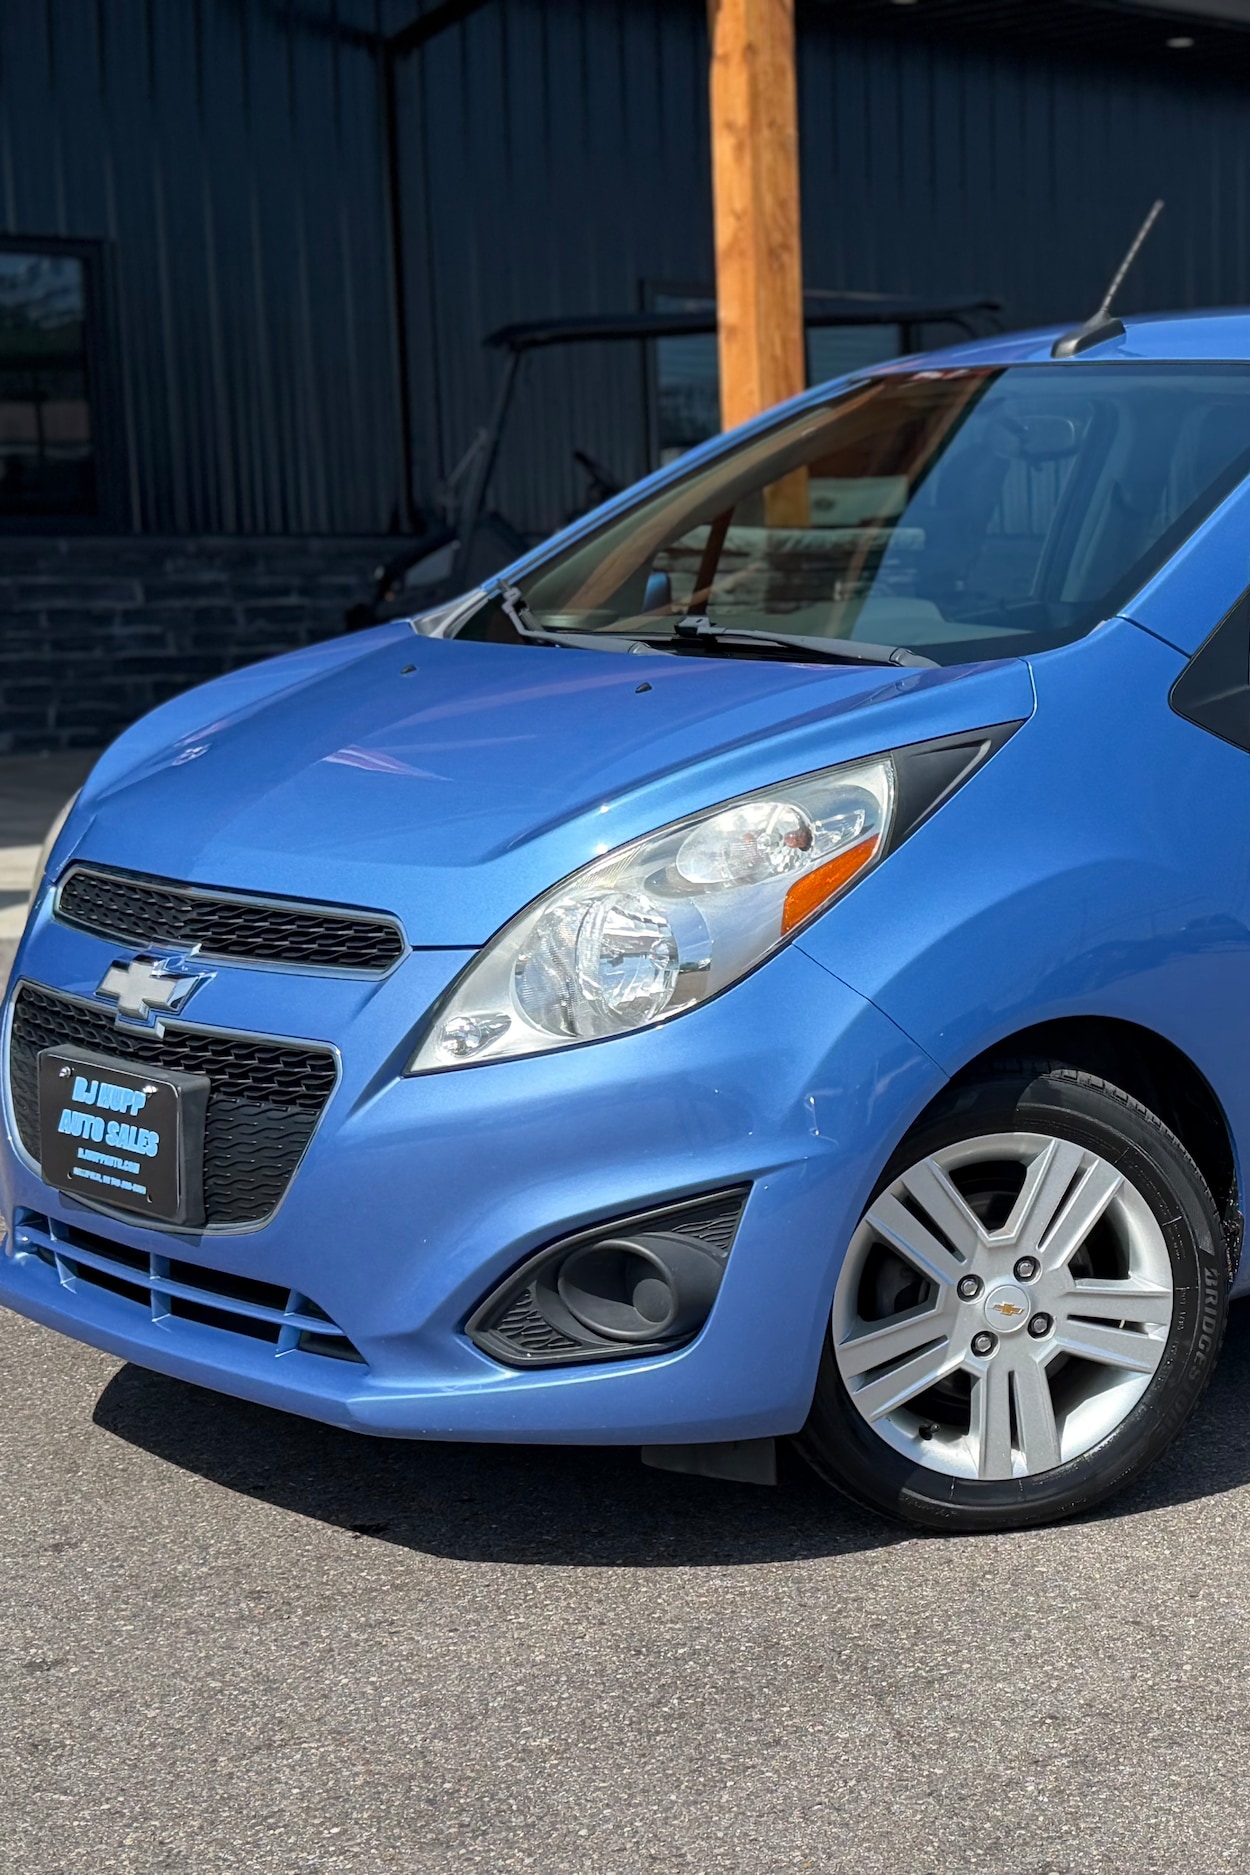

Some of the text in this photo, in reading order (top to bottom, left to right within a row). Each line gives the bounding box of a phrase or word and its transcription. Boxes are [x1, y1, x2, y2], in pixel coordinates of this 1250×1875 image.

[72, 1076, 147, 1116] DJ HUPP
[58, 1109, 159, 1157] AUTO SALES
